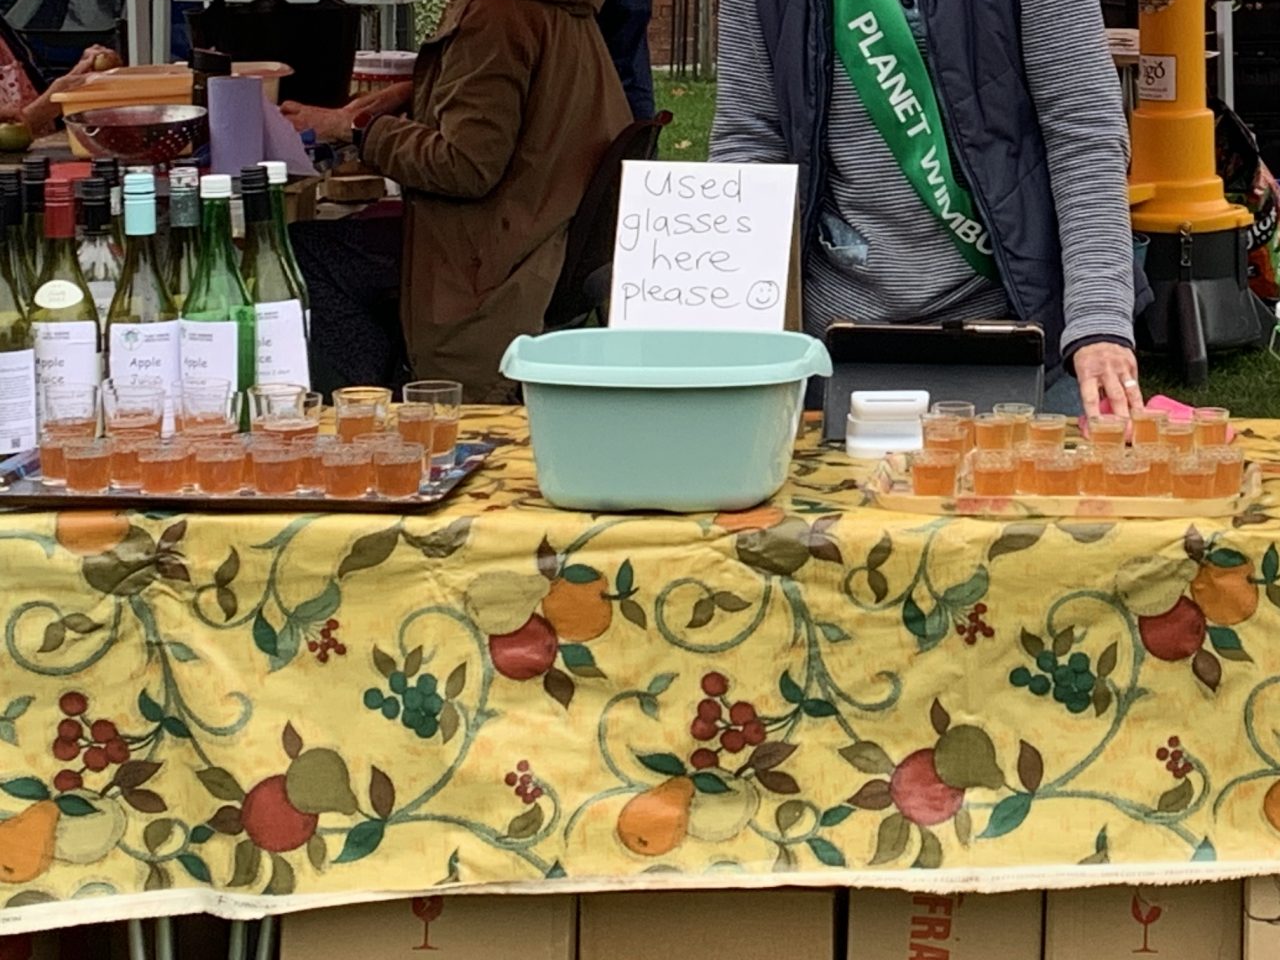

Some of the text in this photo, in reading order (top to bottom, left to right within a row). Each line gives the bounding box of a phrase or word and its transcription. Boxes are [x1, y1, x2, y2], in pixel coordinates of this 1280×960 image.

[847, 11, 931, 138] PLANET
[644, 169, 742, 203] Used
[619, 208, 752, 252] glasses
[651, 238, 741, 272] here
[621, 278, 741, 321] please
[130, 357, 162, 373] Apple
